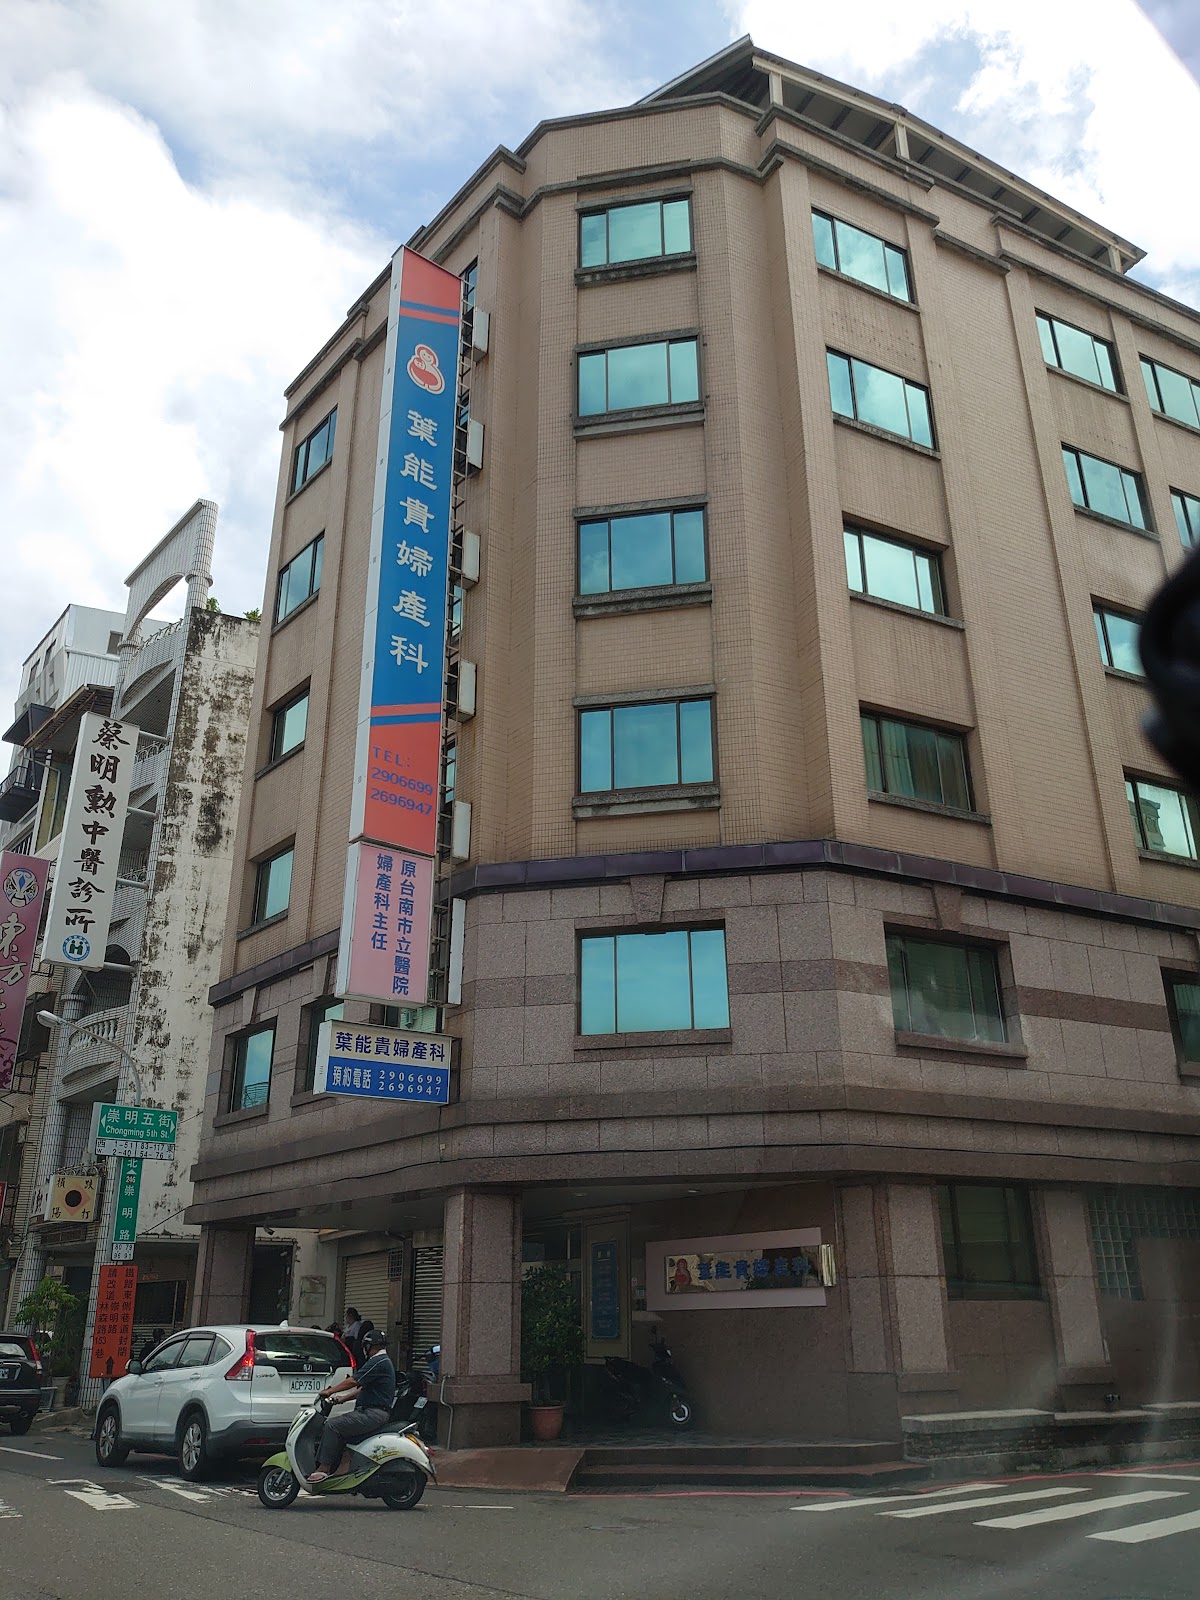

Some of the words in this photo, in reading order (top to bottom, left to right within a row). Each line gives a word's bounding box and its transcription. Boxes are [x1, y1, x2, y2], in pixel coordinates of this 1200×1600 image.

[388, 409, 438, 676] 葉能貴婦產科
[372, 746, 412, 768] TEL:
[371, 767, 433, 797] 2906699
[370, 787, 433, 816] 2696947
[65, 720, 131, 934] 蔡明勳中醫診所
[371, 853, 393, 952] 婦產科主任
[392, 859, 417, 996] 原台南市立醫院
[335, 1031, 445, 1062] 葉能貴婦產科
[332, 1065, 372, 1090] 預約電話
[378, 1070, 442, 1085] 2906699
[378, 1082, 441, 1096] 2696947
[107, 1108, 172, 1128] 崇明五街
[97, 1139, 106, 1148] 西
[105, 1125, 145, 1138] Chongming
[146, 1129, 158, 1138] 5th
[160, 1130, 170, 1139] St.
[127, 1158, 138, 1168] 北
[119, 1185, 135, 1241] 崇明路
